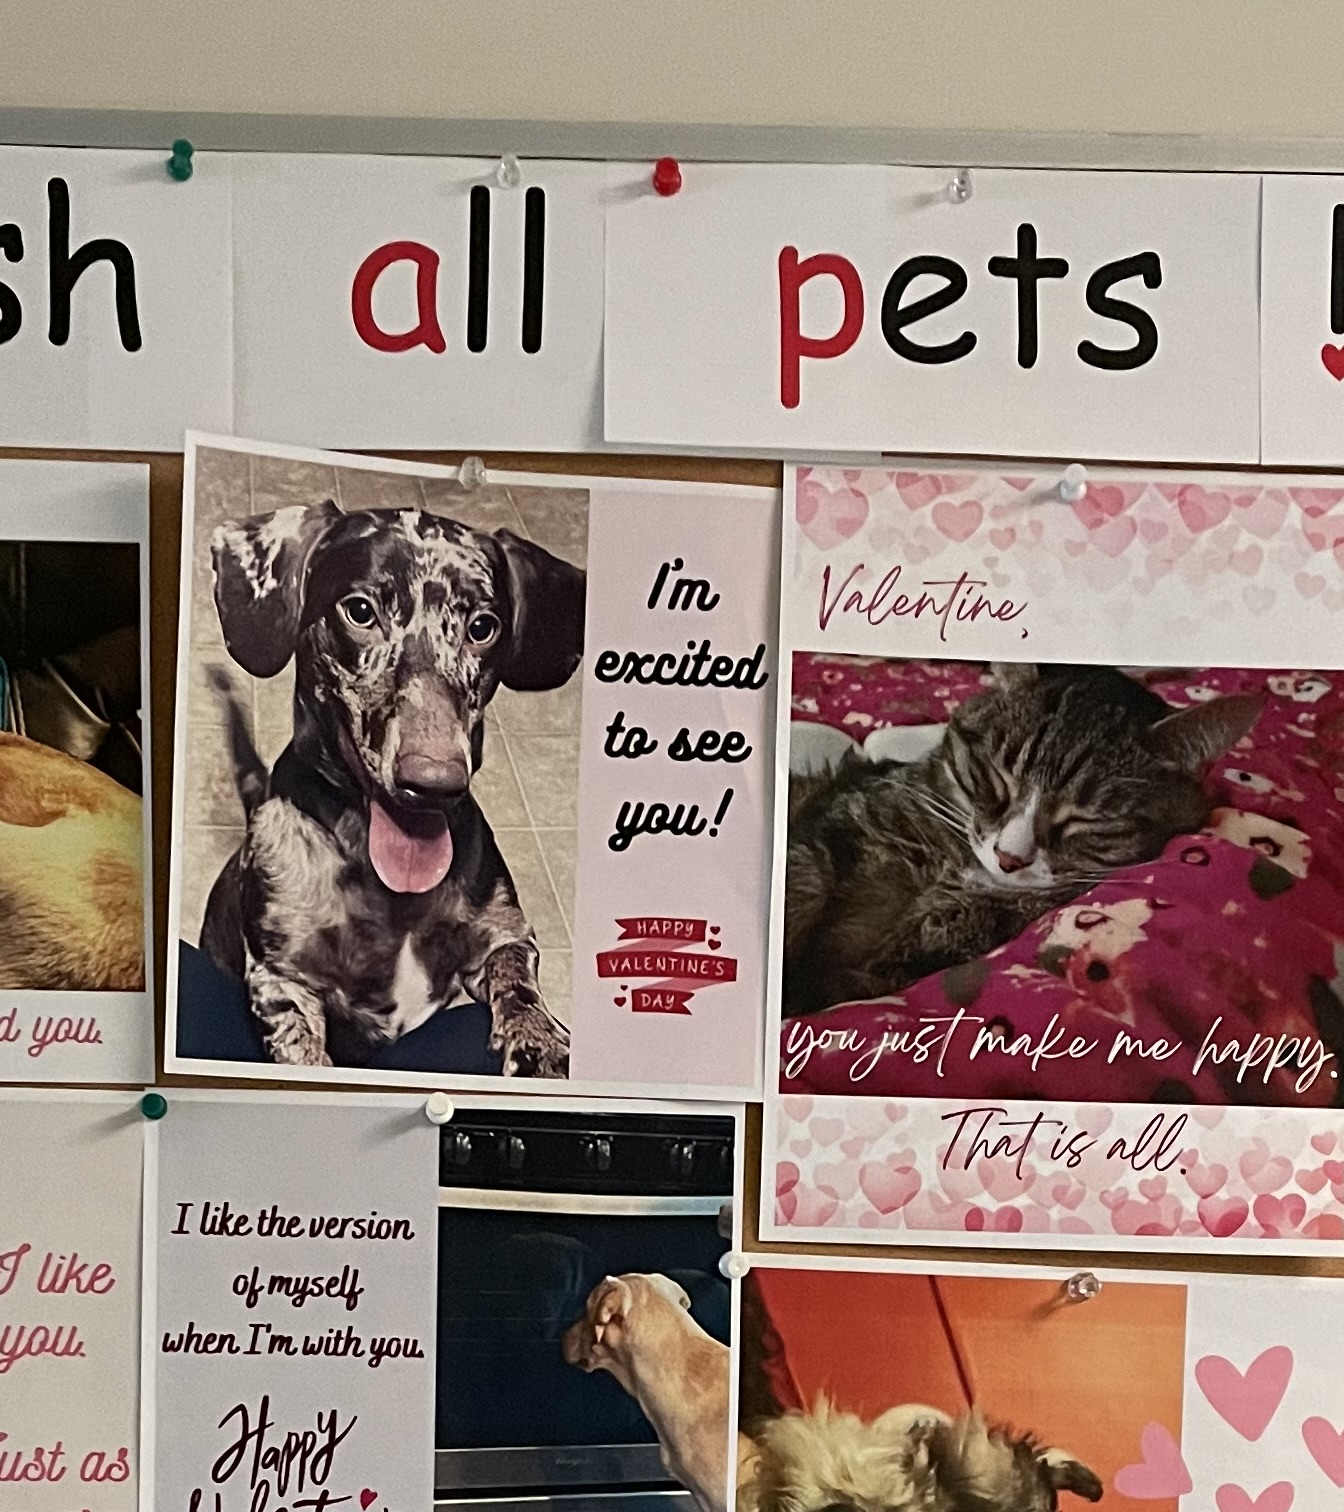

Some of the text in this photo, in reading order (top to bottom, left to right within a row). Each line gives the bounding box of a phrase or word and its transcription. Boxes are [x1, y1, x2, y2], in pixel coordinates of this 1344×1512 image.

[350, 184, 547, 355] all
[780, 221, 1162, 410] pets
[648, 557, 721, 612] I'm
[595, 639, 768, 690] excited
[604, 712, 753, 763] to see
[608, 788, 734, 852] you!
[636, 921, 694, 939] HAPPY
[609, 955, 726, 977] VALENTINE'S
[641, 993, 676, 1009] DAY
[785, 1007, 1340, 1093] you just make me happy.
[941, 1107, 1188, 1180] That is all.
[171, 1202, 415, 1240] I like the version
[37, 1253, 115, 1294] like
[232, 1265, 364, 1311] of myself
[161, 1322, 365, 1358] when I'm with
[80, 1448, 130, 1482] as
[211, 1395, 357, 1497] Happy
